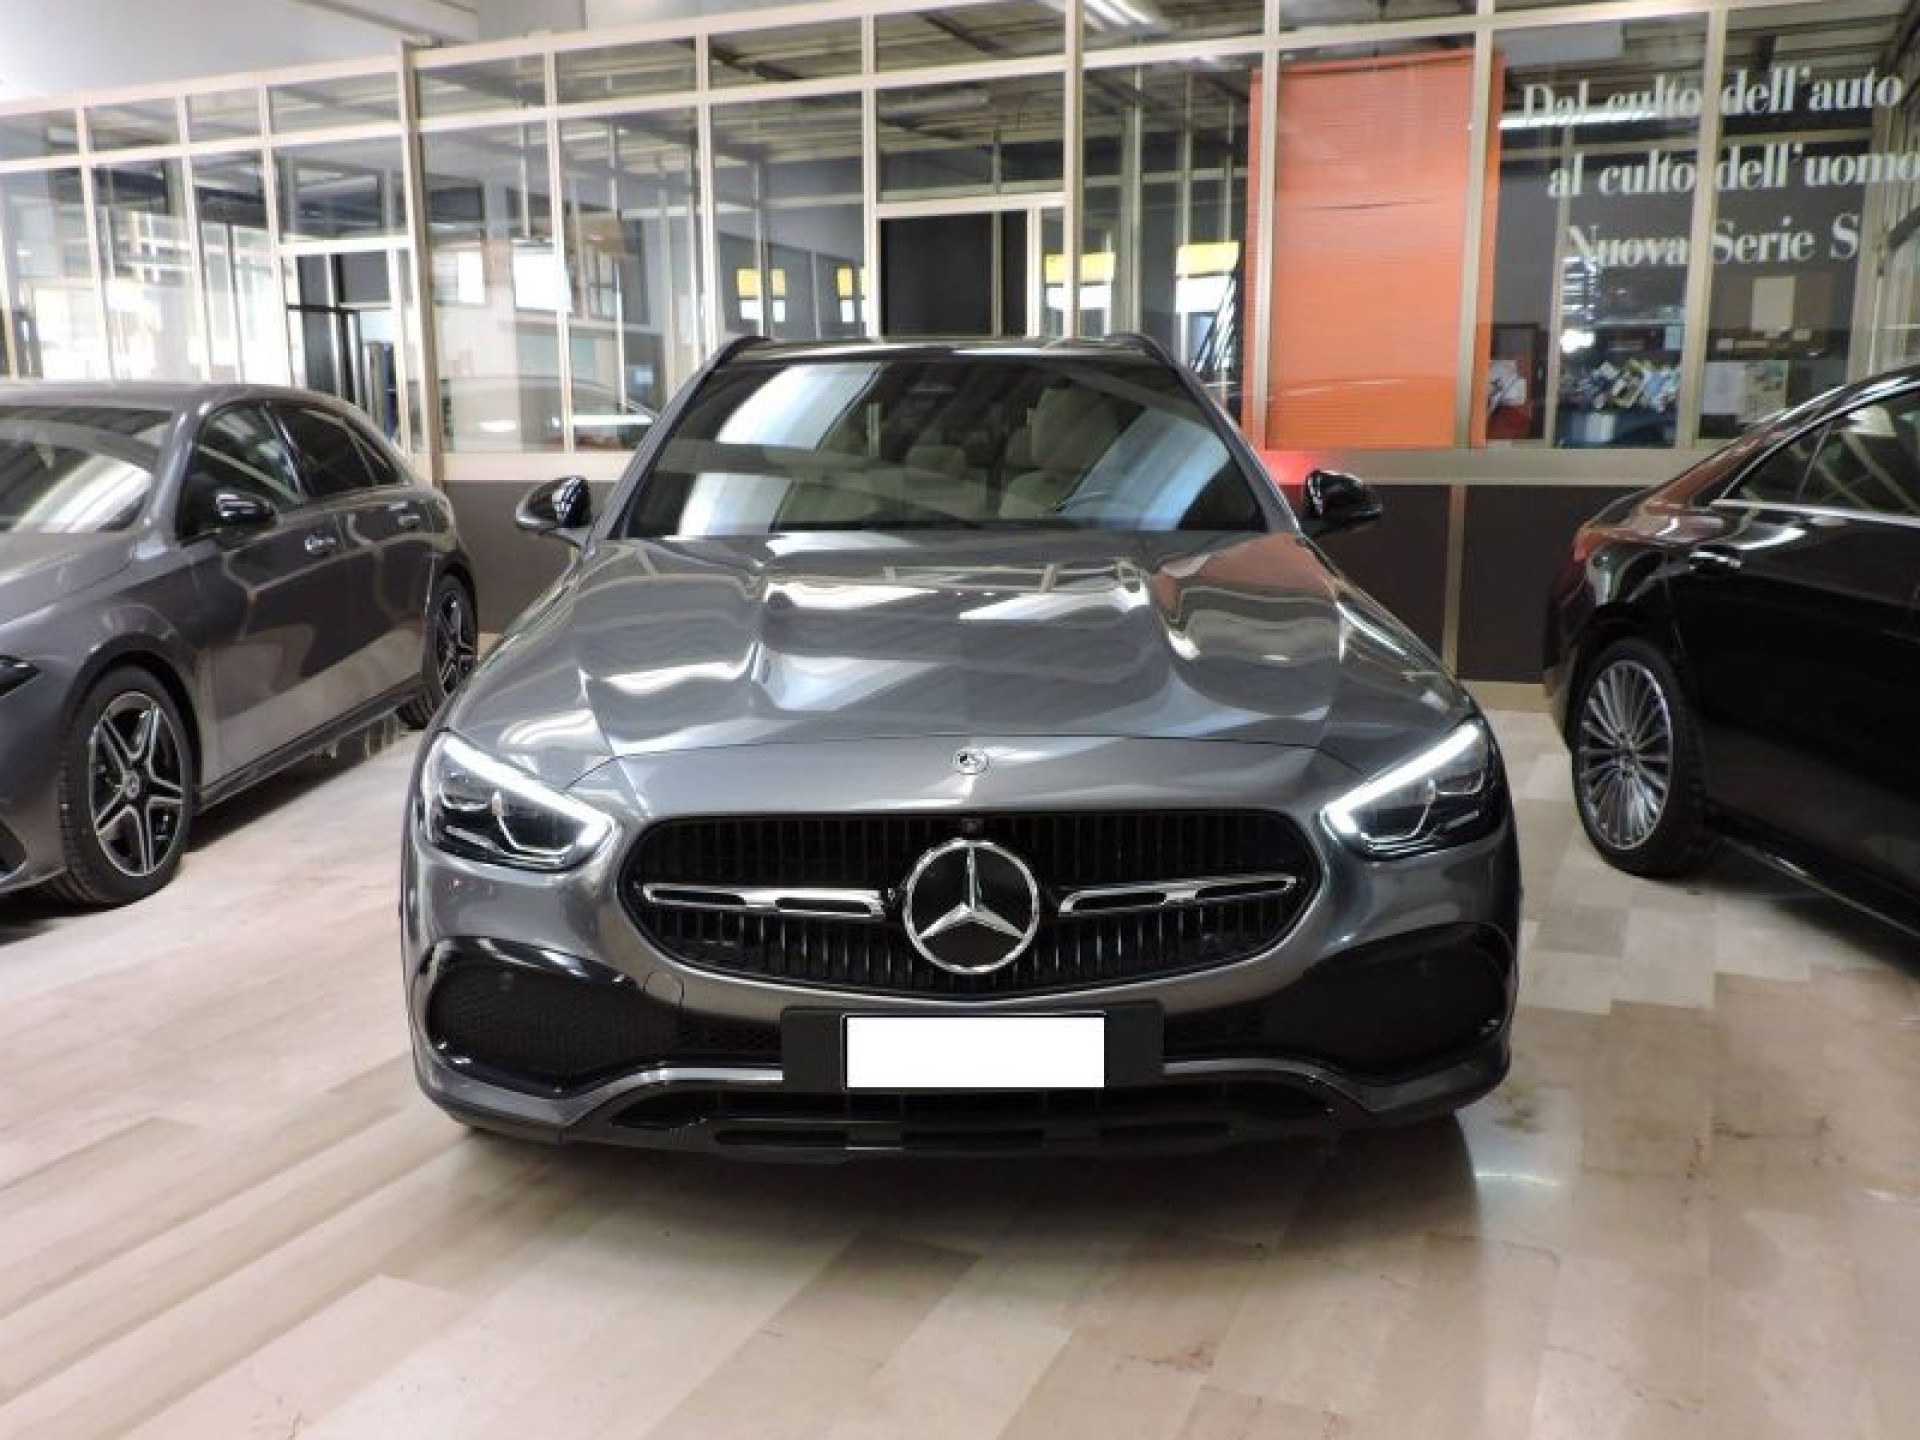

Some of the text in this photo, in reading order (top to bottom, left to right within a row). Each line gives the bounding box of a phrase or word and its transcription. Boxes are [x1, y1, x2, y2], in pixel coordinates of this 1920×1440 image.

[1523, 66, 1902, 119] Dal culto dell'auto
[1547, 143, 1920, 197] al culto dell'uomo
[1563, 225, 1689, 267] Nuova
[1711, 214, 1816, 265] Serie
